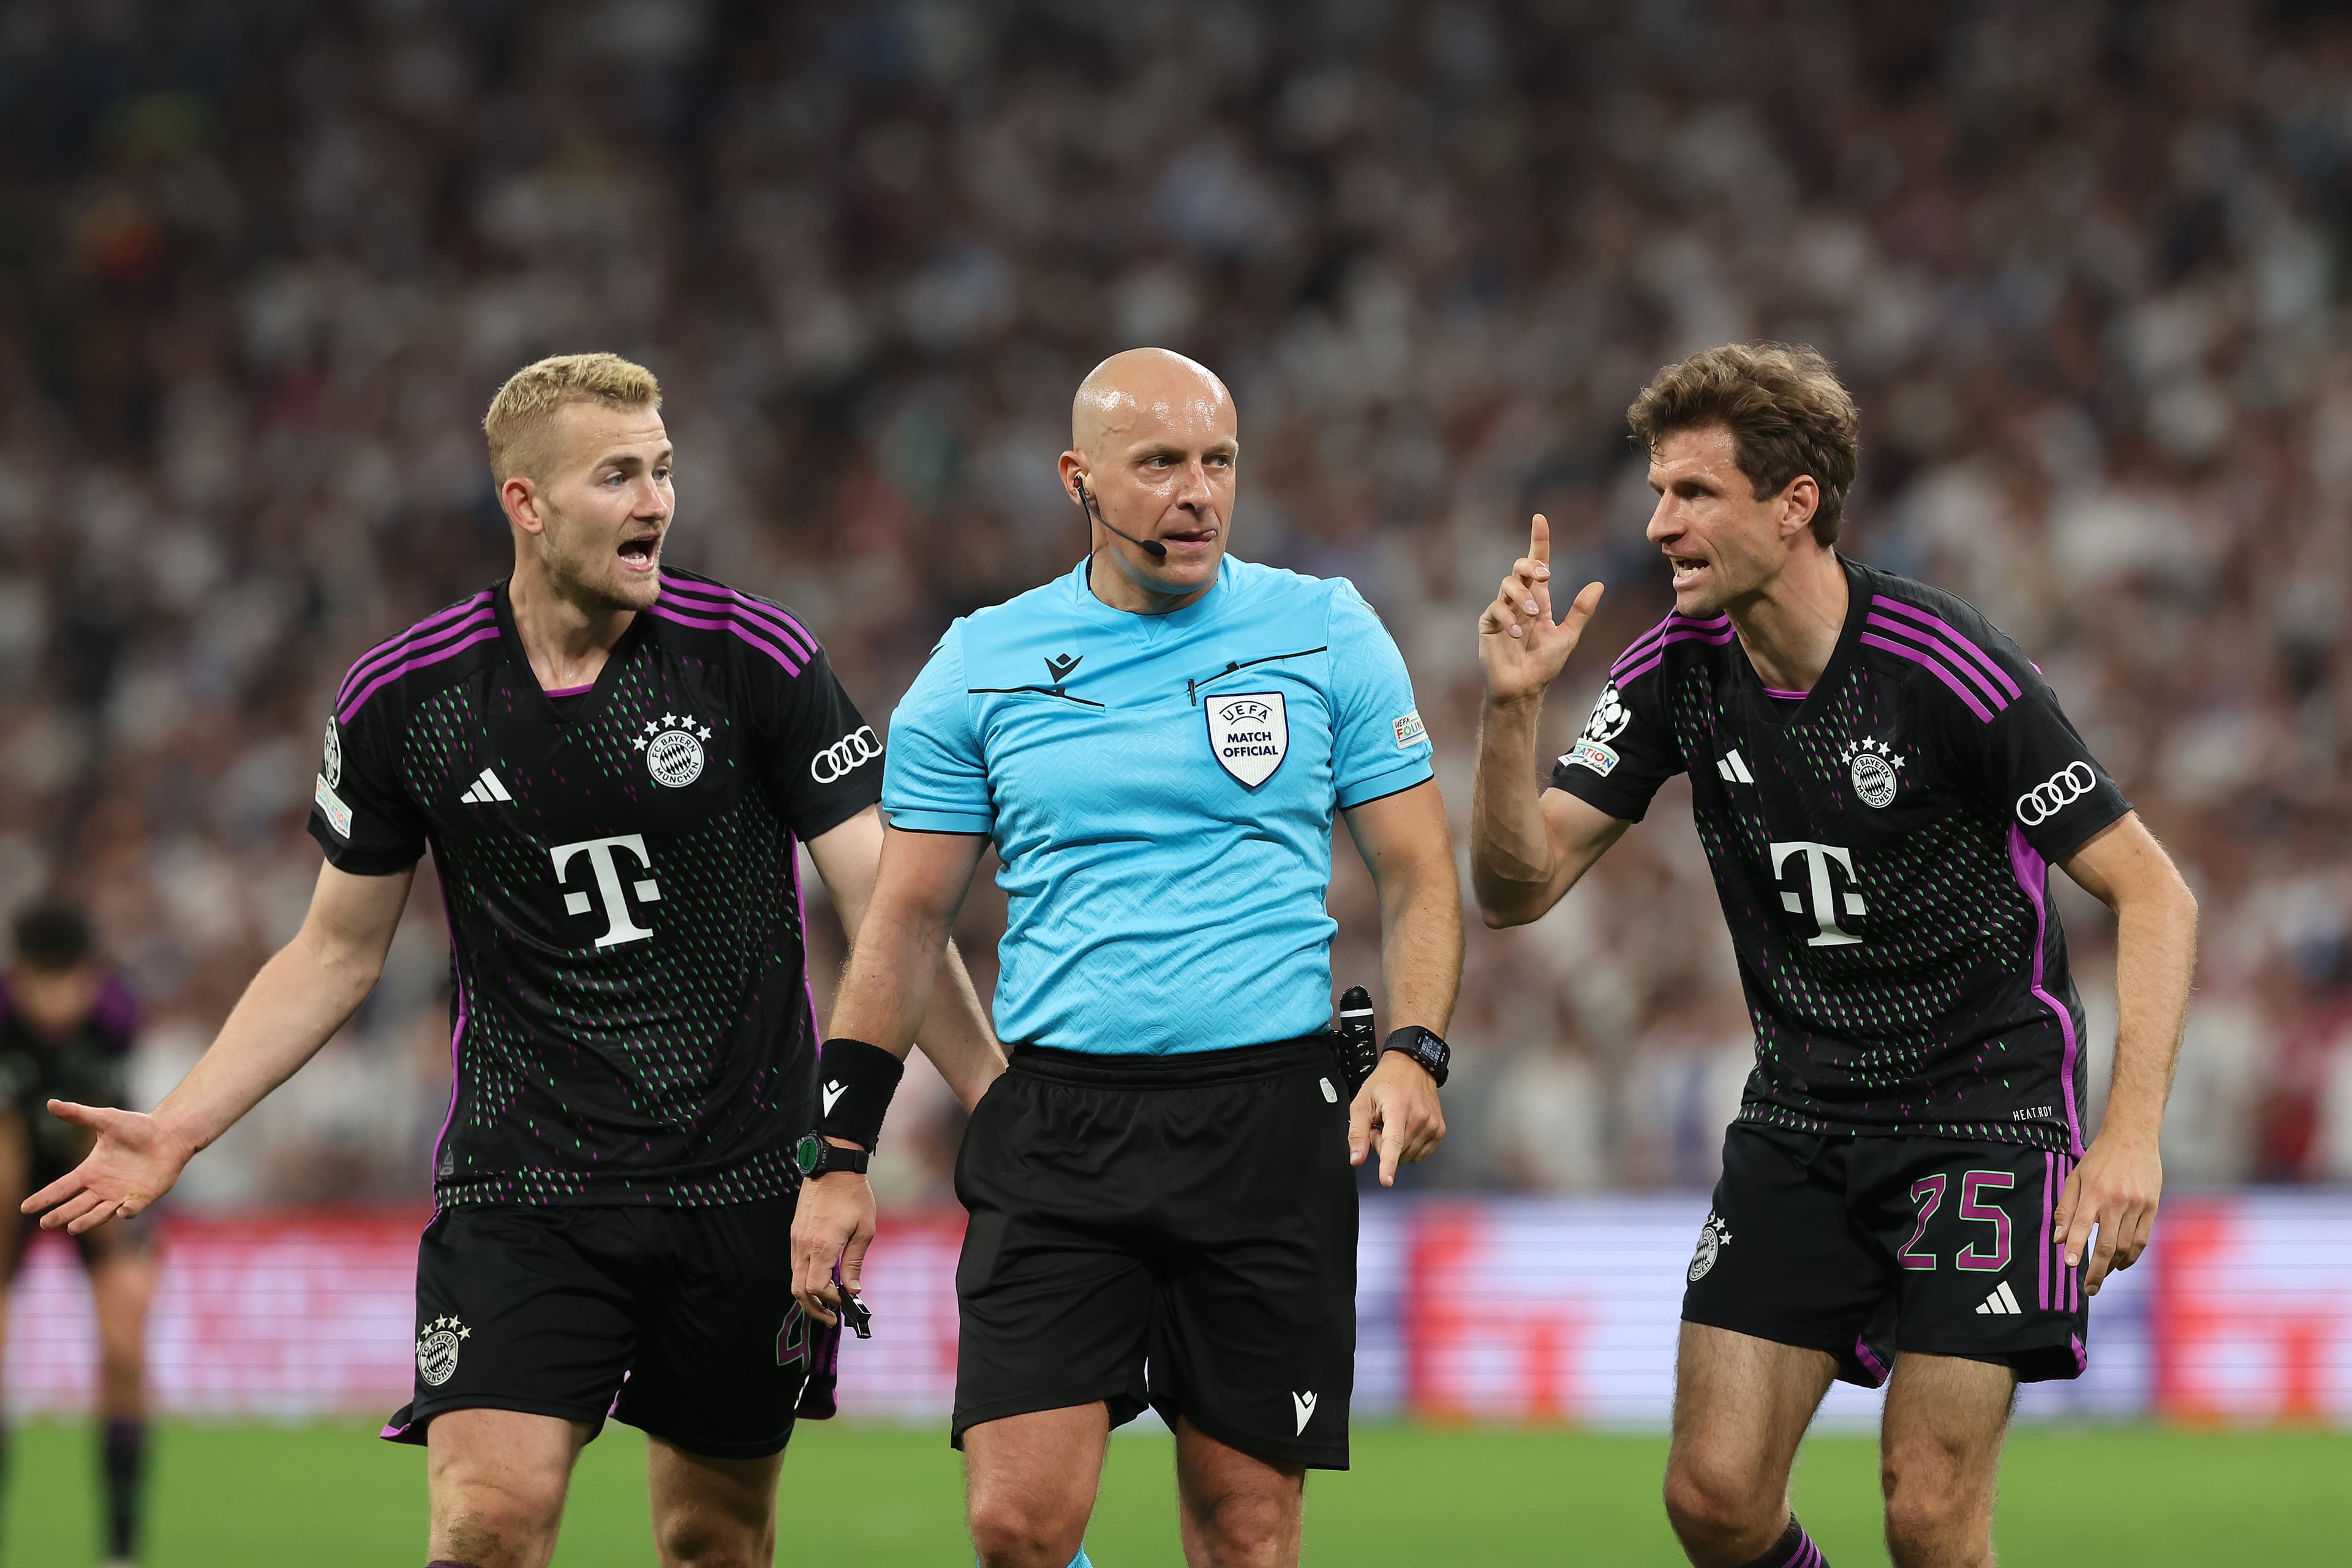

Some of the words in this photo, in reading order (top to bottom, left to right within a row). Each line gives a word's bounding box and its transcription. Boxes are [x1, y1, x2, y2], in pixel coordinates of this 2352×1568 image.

[1223, 705, 1268, 721] UEFA
[1395, 717, 1410, 728] UEFA
[652, 746, 662, 758] FC
[661, 736, 697, 753] BAYERN
[1227, 731, 1272, 743] MATCH
[1223, 745, 1278, 758] OFFICIAL
[1855, 764, 1861, 776] FC
[1860, 759, 1890, 778] BAYERN
[550, 834, 654, 948] T
[1770, 842, 1863, 946] T
[1898, 1170, 2015, 1272] 25
[421, 1346, 429, 1357] FC
[430, 1335, 455, 1351] BAYERN
[776, 1298, 812, 1373] 4
